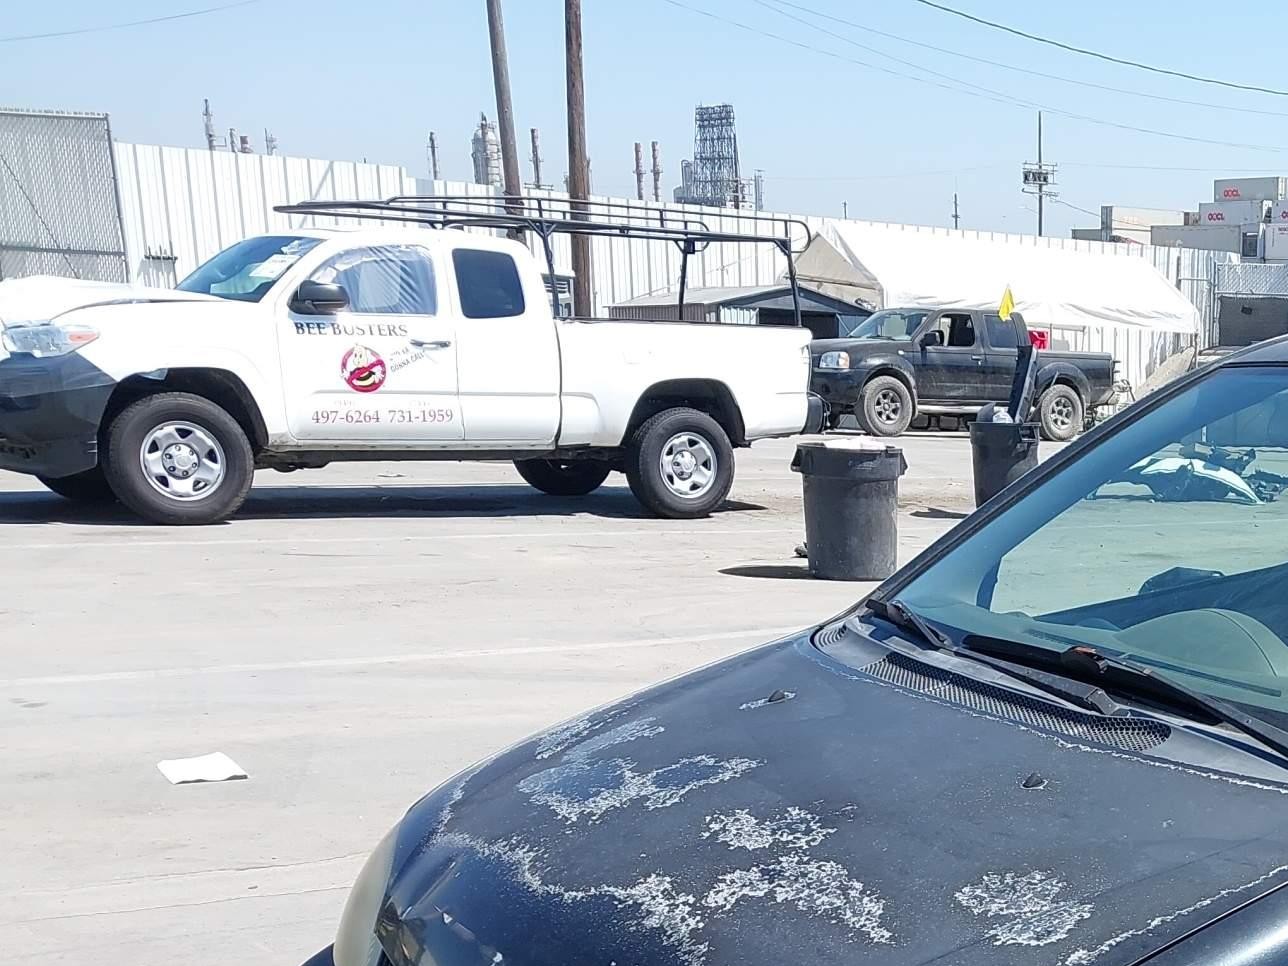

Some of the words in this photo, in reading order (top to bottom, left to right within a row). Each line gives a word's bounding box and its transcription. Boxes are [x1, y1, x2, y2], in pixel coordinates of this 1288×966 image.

[1224, 189, 1240, 198] OOCL
[1208, 213, 1224, 221] OOCL
[295, 322, 328, 335] BEE
[331, 323, 408, 337] BUSTERS
[312, 410, 380, 424] 497-6264
[388, 409, 454, 423] 731-1959
